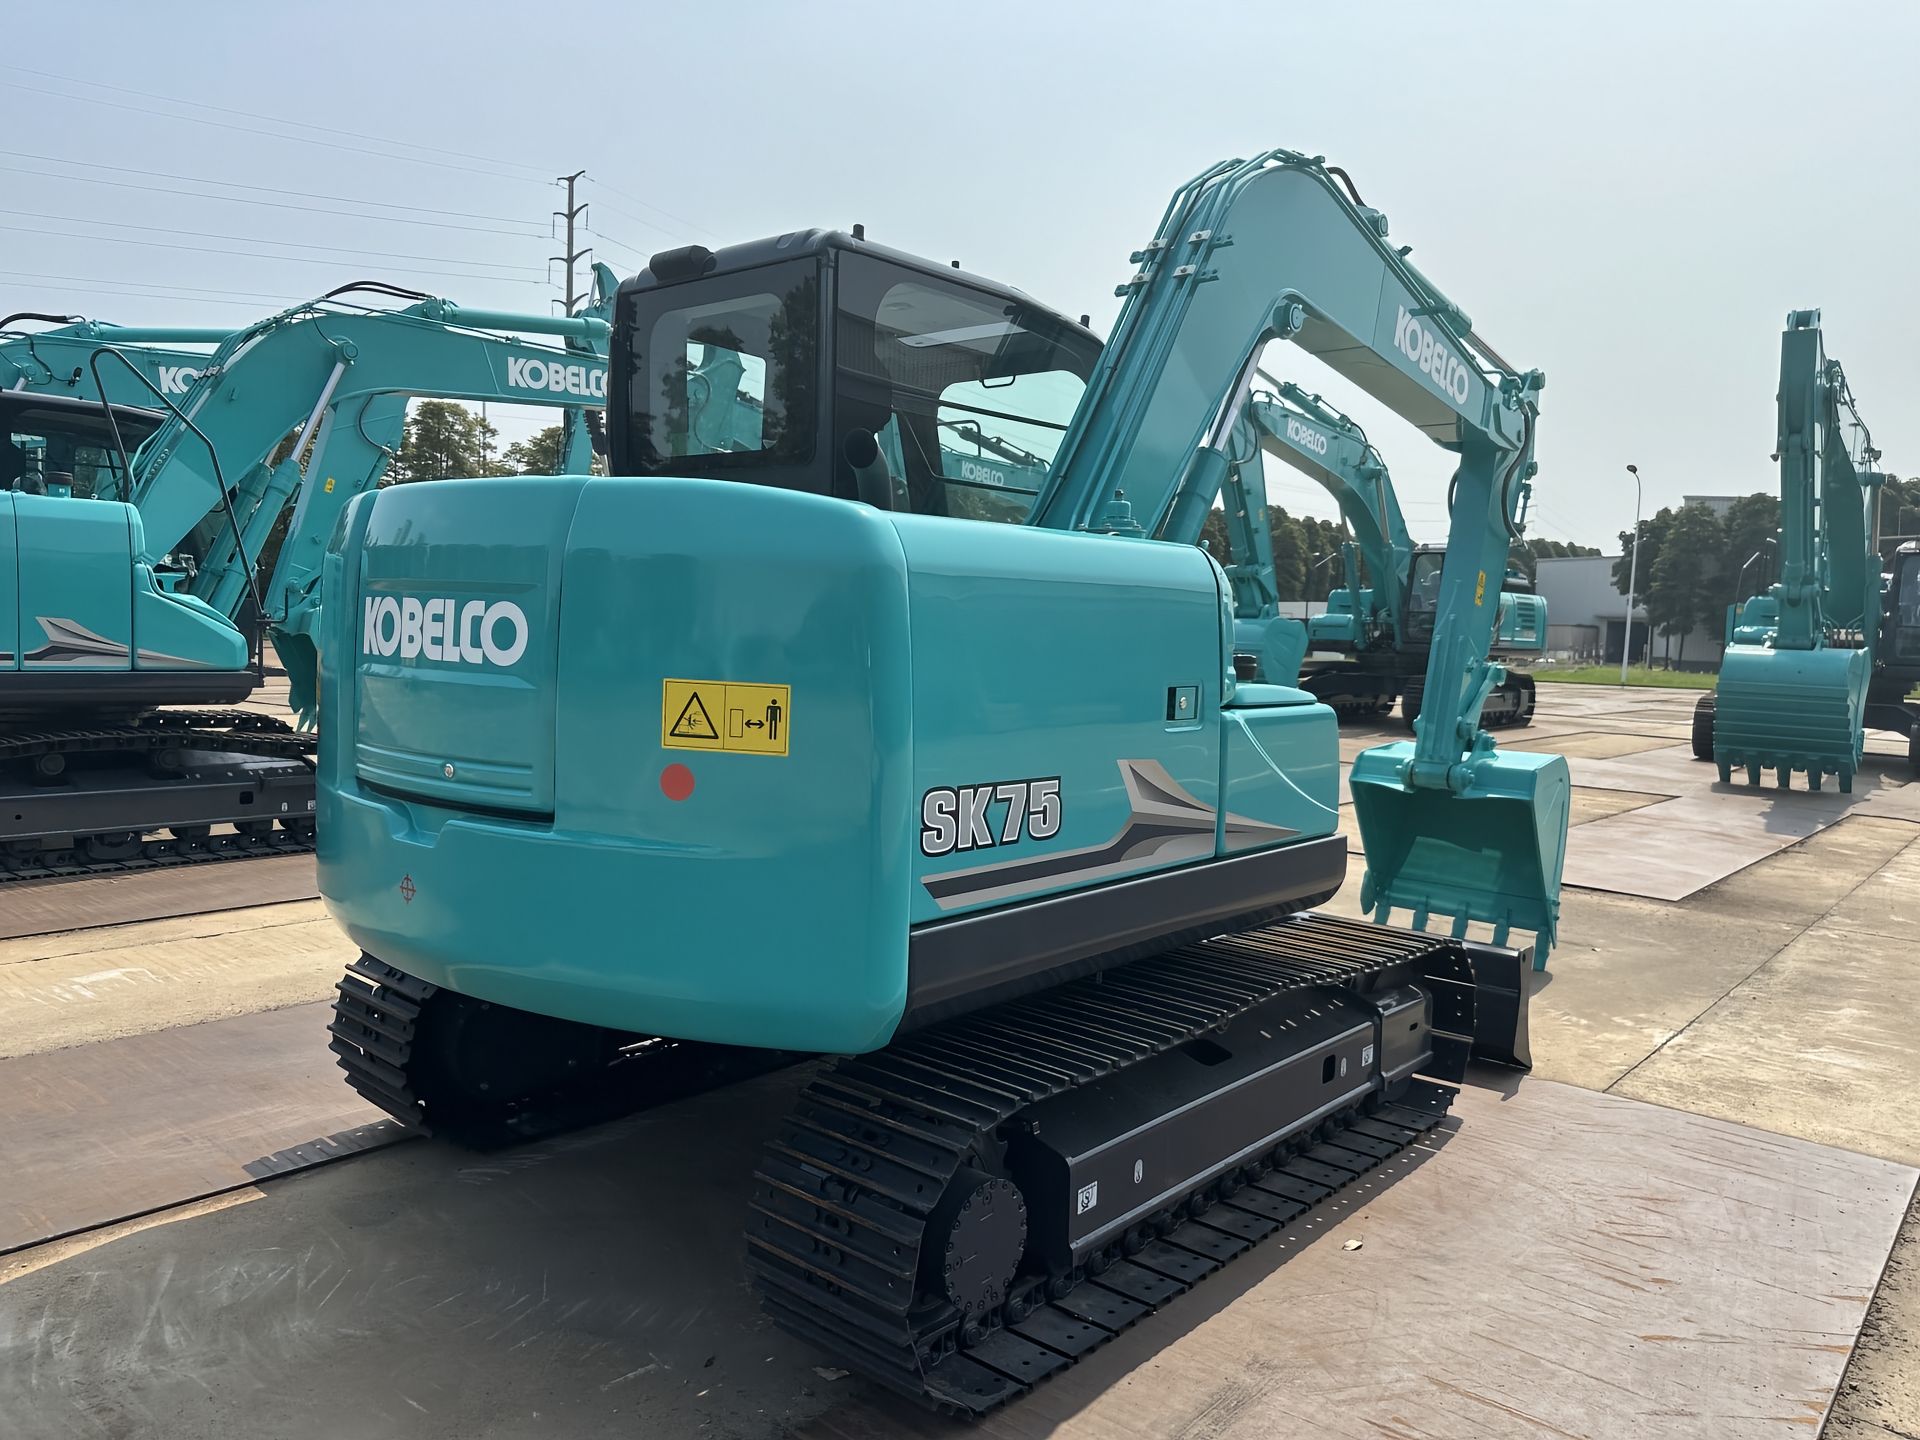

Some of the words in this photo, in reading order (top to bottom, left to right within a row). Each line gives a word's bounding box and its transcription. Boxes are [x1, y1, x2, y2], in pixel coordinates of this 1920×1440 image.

[507, 356, 608, 398] KOBELC
[1393, 304, 1469, 405] KOBELCO
[1287, 417, 1327, 455] KOBELCO
[961, 460, 1004, 486] KOBELCO
[363, 596, 529, 667] KOBELCO
[920, 776, 1062, 857] SK75
